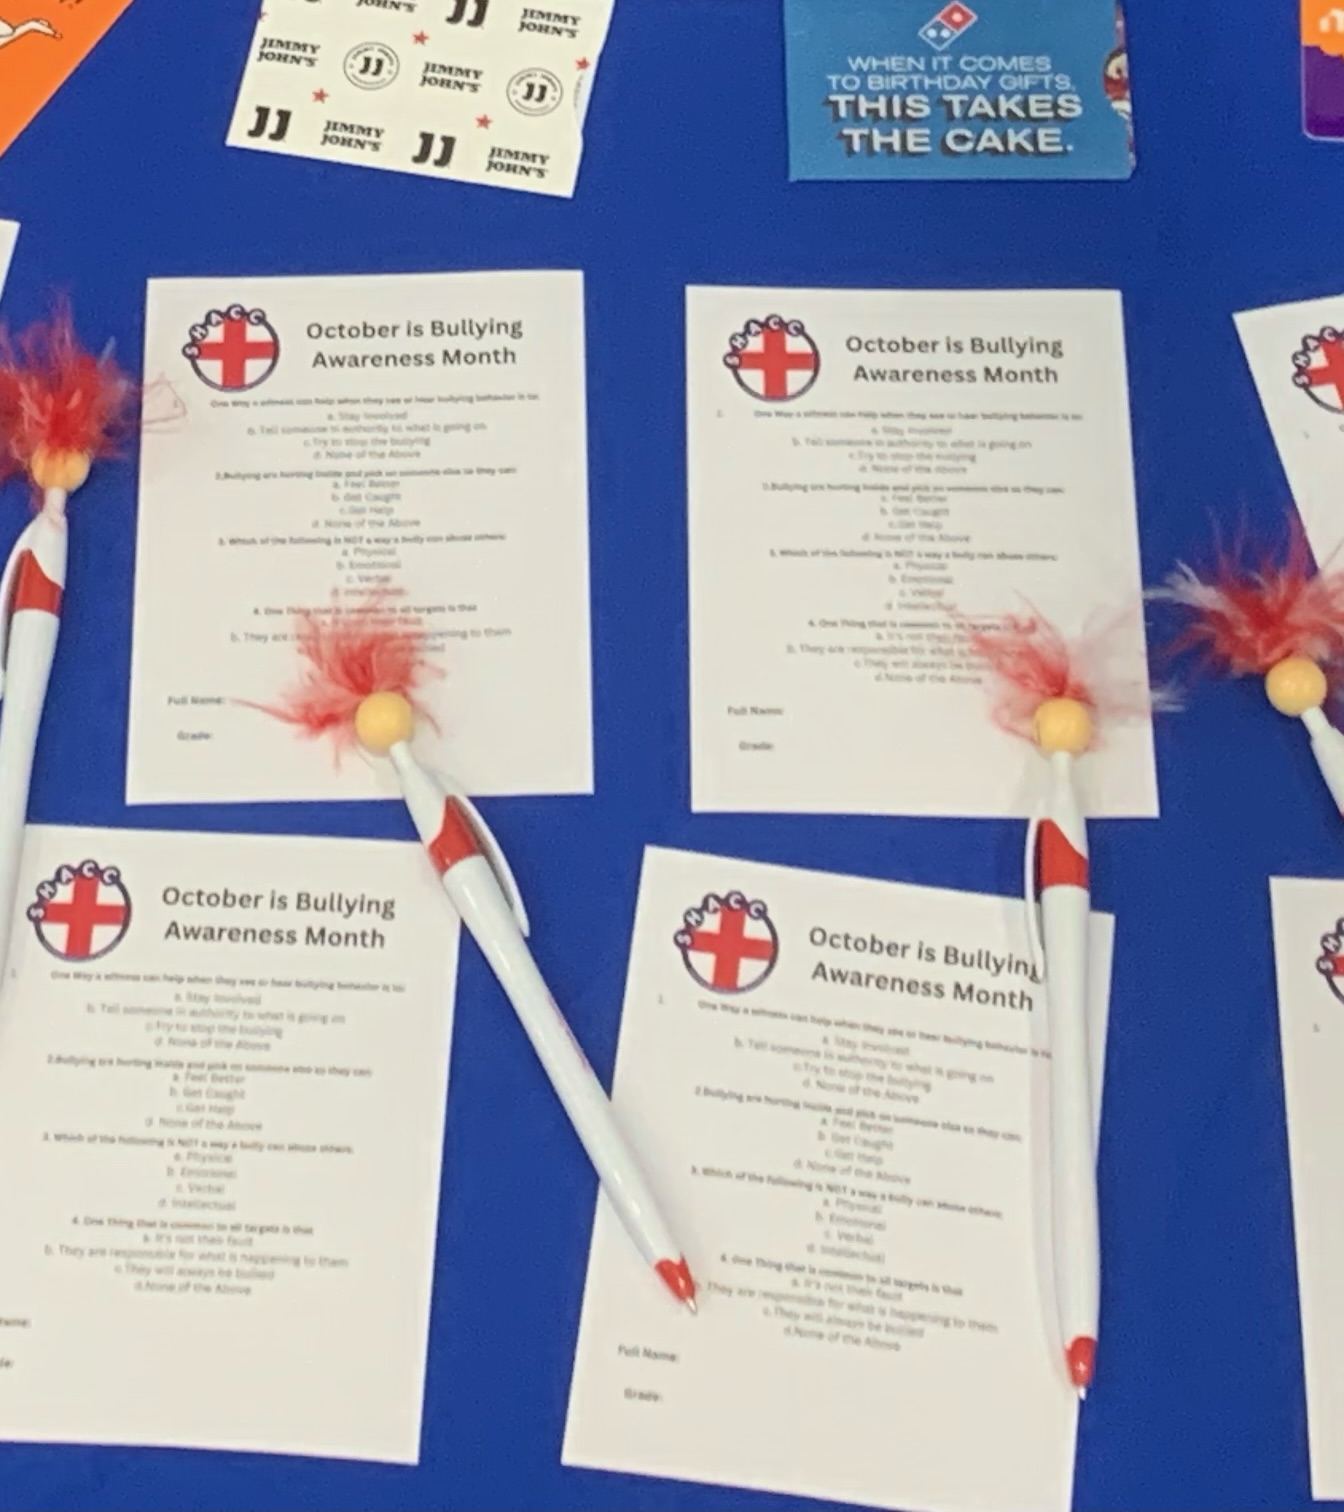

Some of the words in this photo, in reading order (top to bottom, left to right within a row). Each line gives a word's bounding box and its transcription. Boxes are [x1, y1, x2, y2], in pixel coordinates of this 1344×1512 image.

[521, 8, 581, 26] JIMMY
[518, 21, 580, 39] JOHN'S
[260, 37, 321, 54] JIMMY
[257, 50, 318, 68] JOHN'S
[359, 57, 384, 76] JJ
[848, 56, 924, 72] WHEN
[932, 56, 953, 71] IT
[958, 55, 1052, 72] COMES
[423, 62, 483, 81] JIMMY
[419, 75, 481, 93] JOHN'S
[522, 83, 547, 103] JJ
[826, 75, 862, 90] TO
[867, 75, 991, 90] BIRTHDAY
[999, 75, 1076, 92] GIFTS,
[826, 93, 931, 119] THIS
[941, 93, 1083, 119] TAKES
[247, 106, 292, 142] JJ
[324, 120, 384, 139] JIMMY
[321, 133, 383, 152] JOHN'S
[840, 127, 932, 153] THE
[945, 127, 1074, 153] CAKE.
[412, 132, 456, 168] JJ
[489, 146, 550, 165] JIMMY
[486, 159, 547, 178] JOHN'S
[306, 320, 401, 341] October
[405, 319, 425, 338] is
[430, 317, 524, 342] Bullying
[311, 350, 436, 369] Awareness
[441, 345, 517, 367] Month
[845, 335, 941, 354] October
[945, 335, 965, 355] is
[969, 335, 1065, 360] Bullying
[852, 364, 978, 384] Awareness
[983, 365, 1059, 384] Month
[161, 886, 265, 910] October
[269, 888, 288, 911] is
[295, 891, 396, 922] Bullying
[163, 919, 298, 946] Awareness
[304, 925, 386, 949] Month
[808, 926, 912, 960] October
[916, 940, 937, 963] is
[810, 960, 946, 1000] Awareness
[952, 980, 1034, 1013] Month
